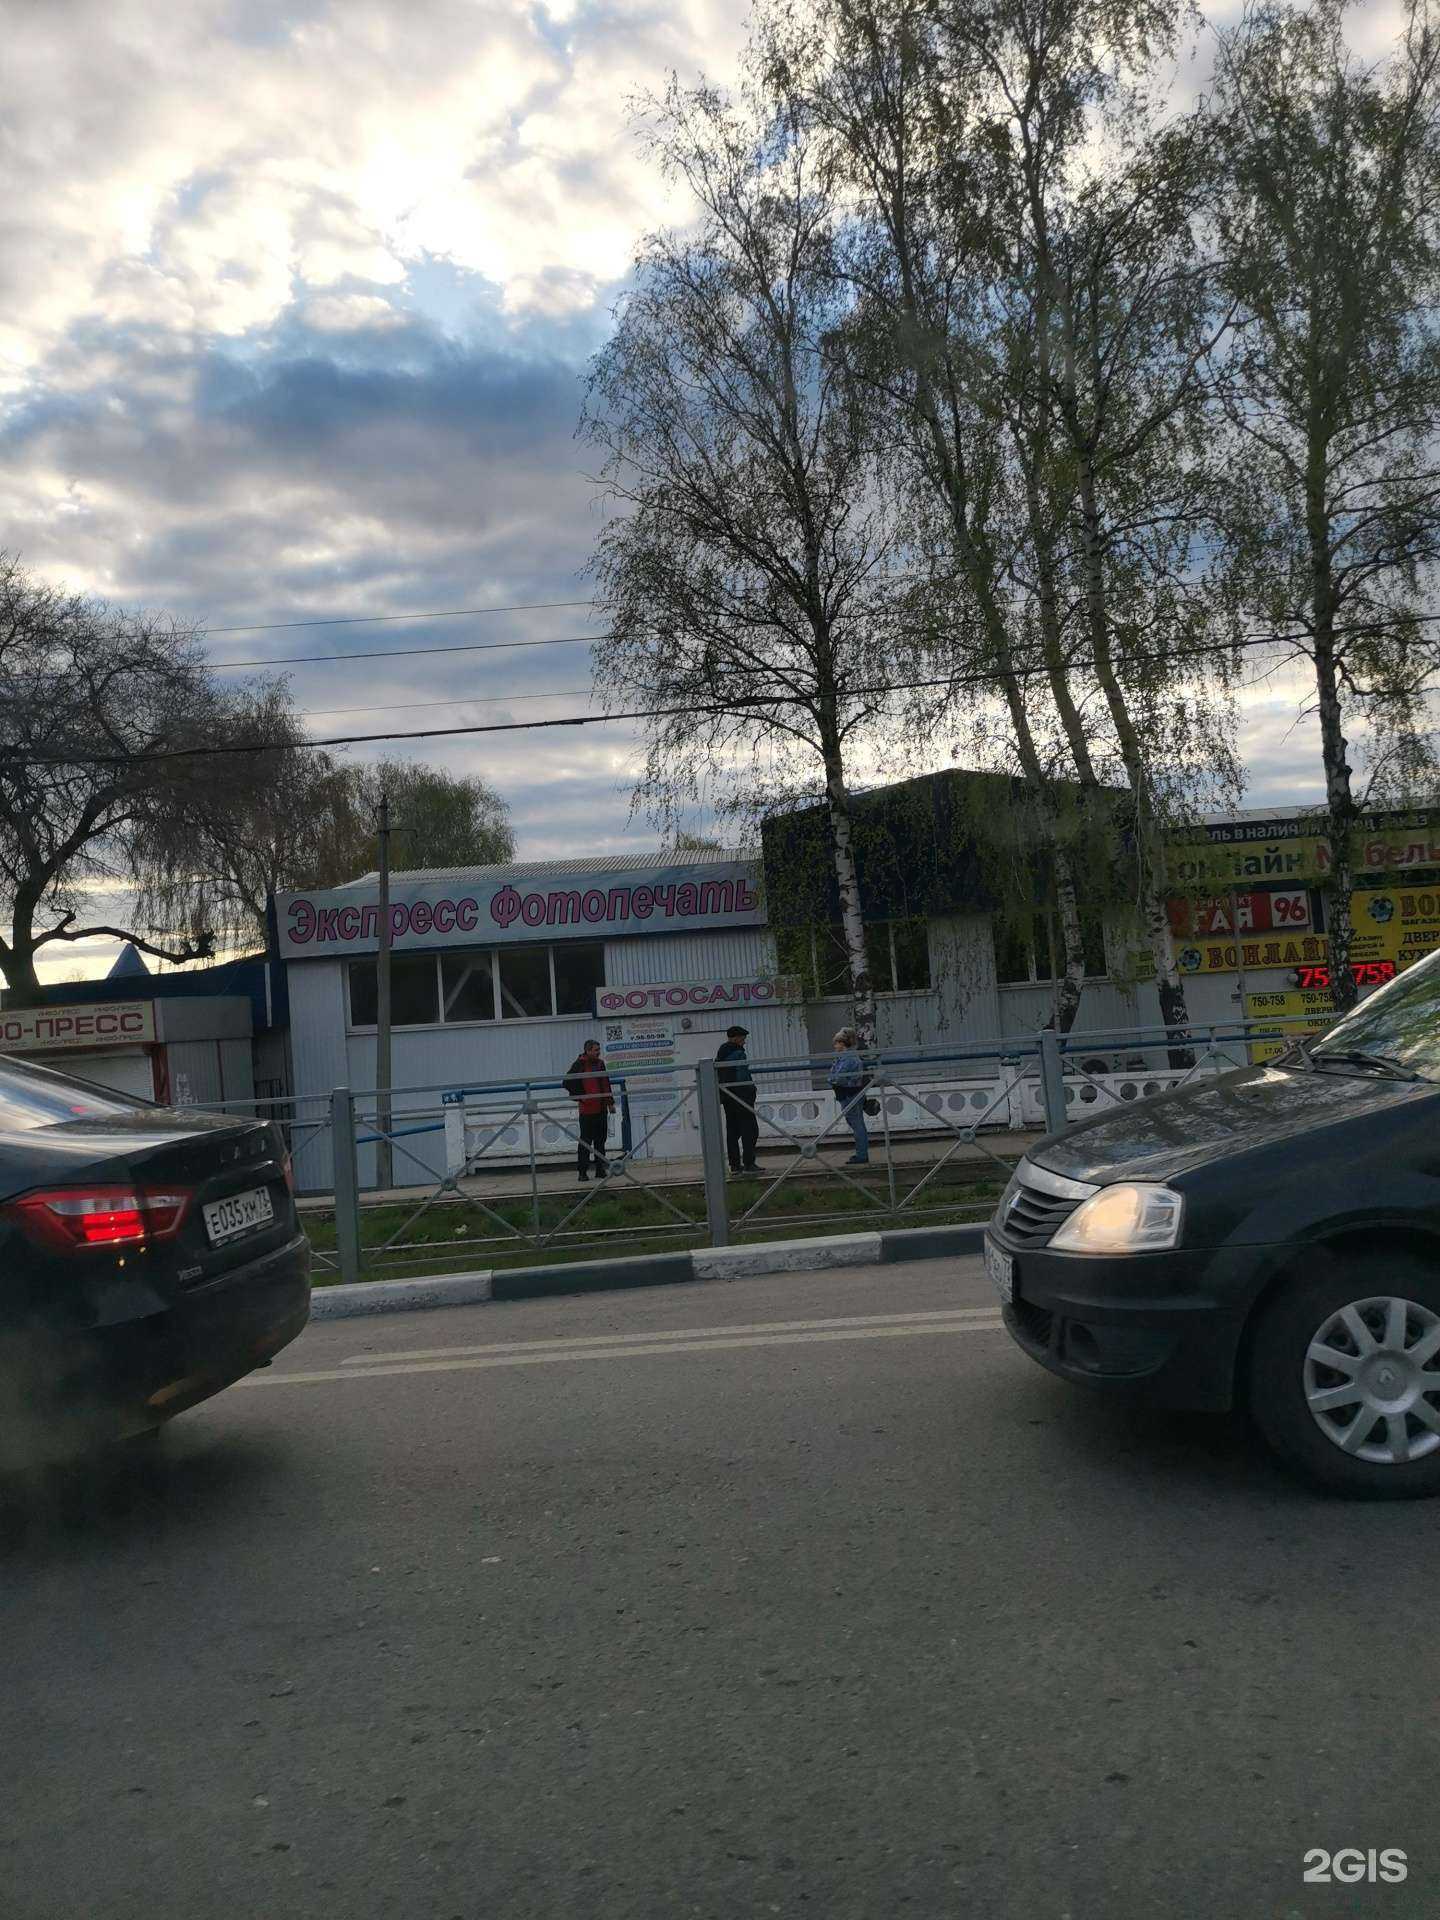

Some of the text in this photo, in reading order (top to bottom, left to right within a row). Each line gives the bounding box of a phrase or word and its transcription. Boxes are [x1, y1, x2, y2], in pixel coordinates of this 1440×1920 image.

[287, 878, 758, 946] Экспресс Фотопечать
[1274, 896, 1306, 923] 96
[1401, 895, 1440, 917] ВО
[0, 1012, 144, 1041] О-ПРЕСС
